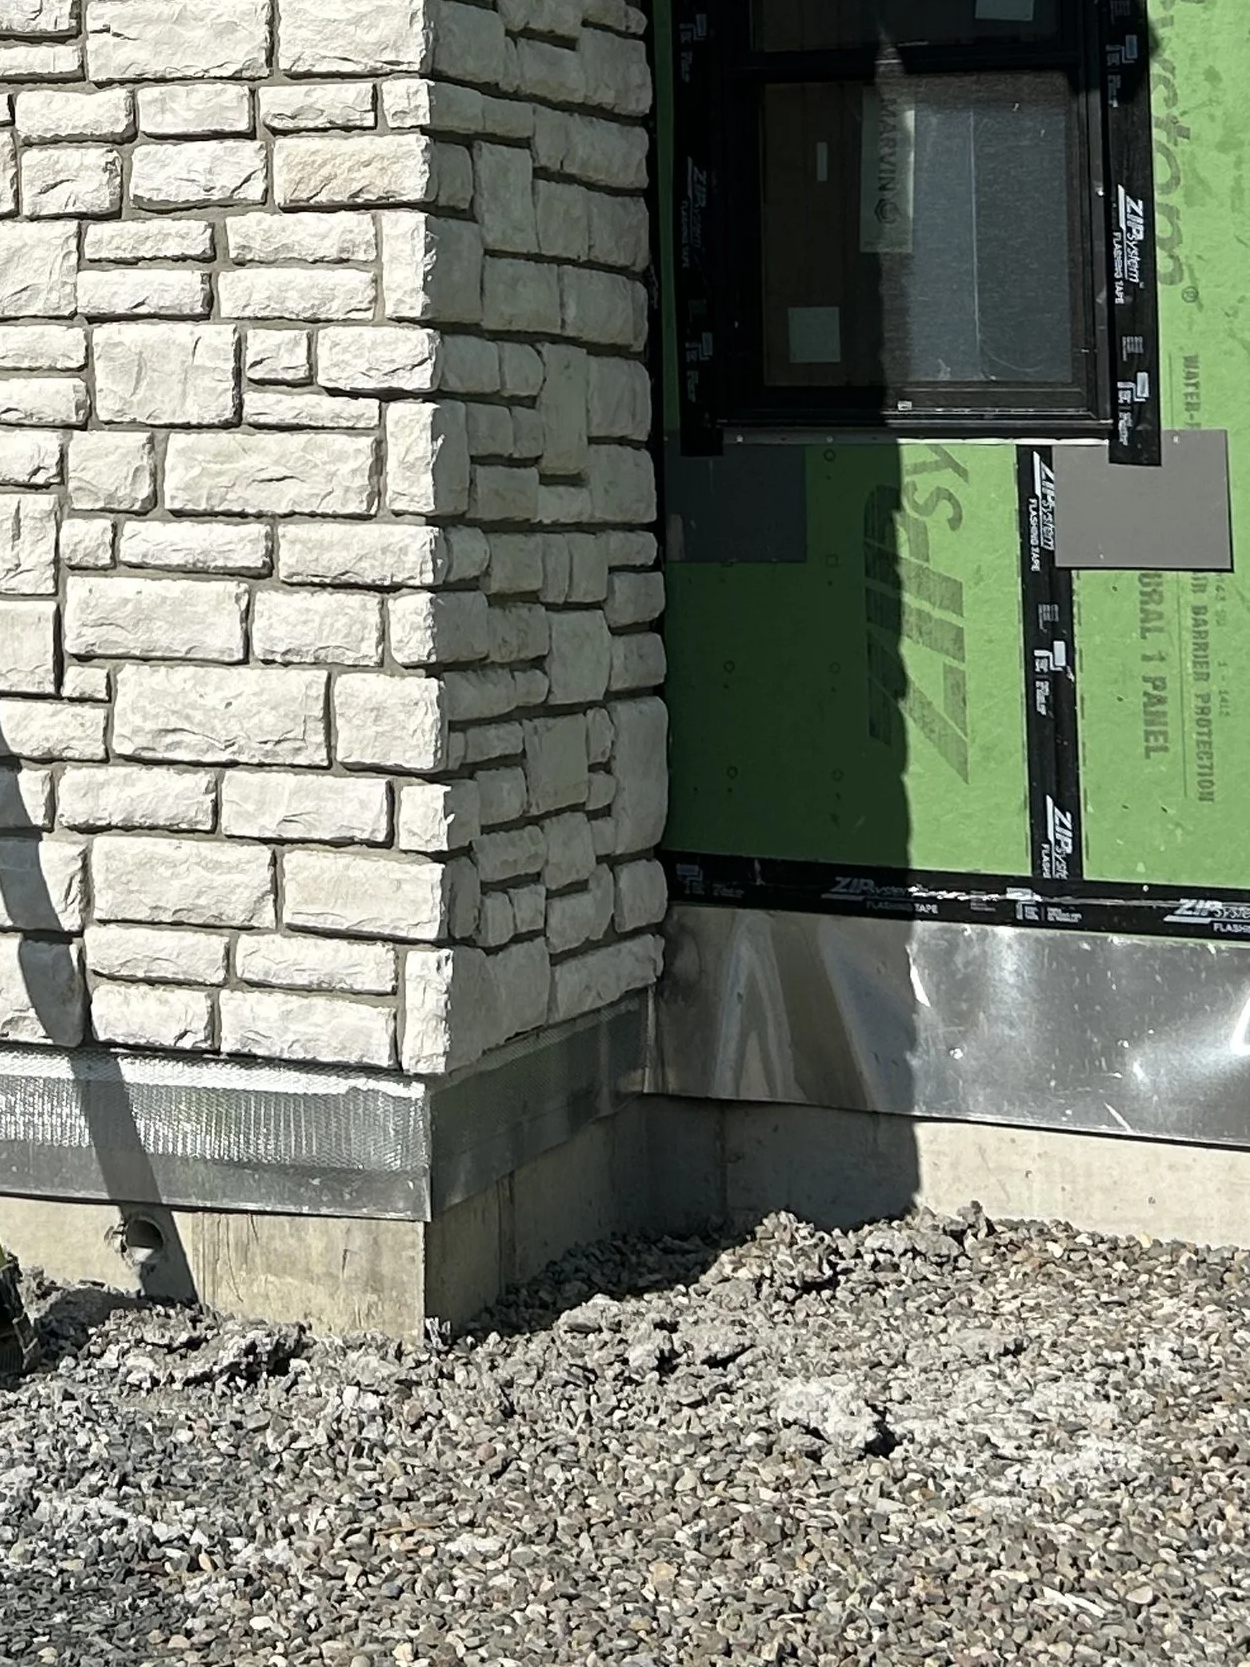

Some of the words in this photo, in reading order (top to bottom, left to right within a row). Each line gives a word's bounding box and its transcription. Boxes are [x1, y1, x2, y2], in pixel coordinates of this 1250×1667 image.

[878, 97, 898, 192] MARVIN
[1141, 650, 1166, 663] 1
[1191, 605, 1211, 682] BARRIER
[1142, 675, 1170, 760] PANEL
[1195, 692, 1216, 803] PROTECTION
[914, 902, 940, 915] TAPE
